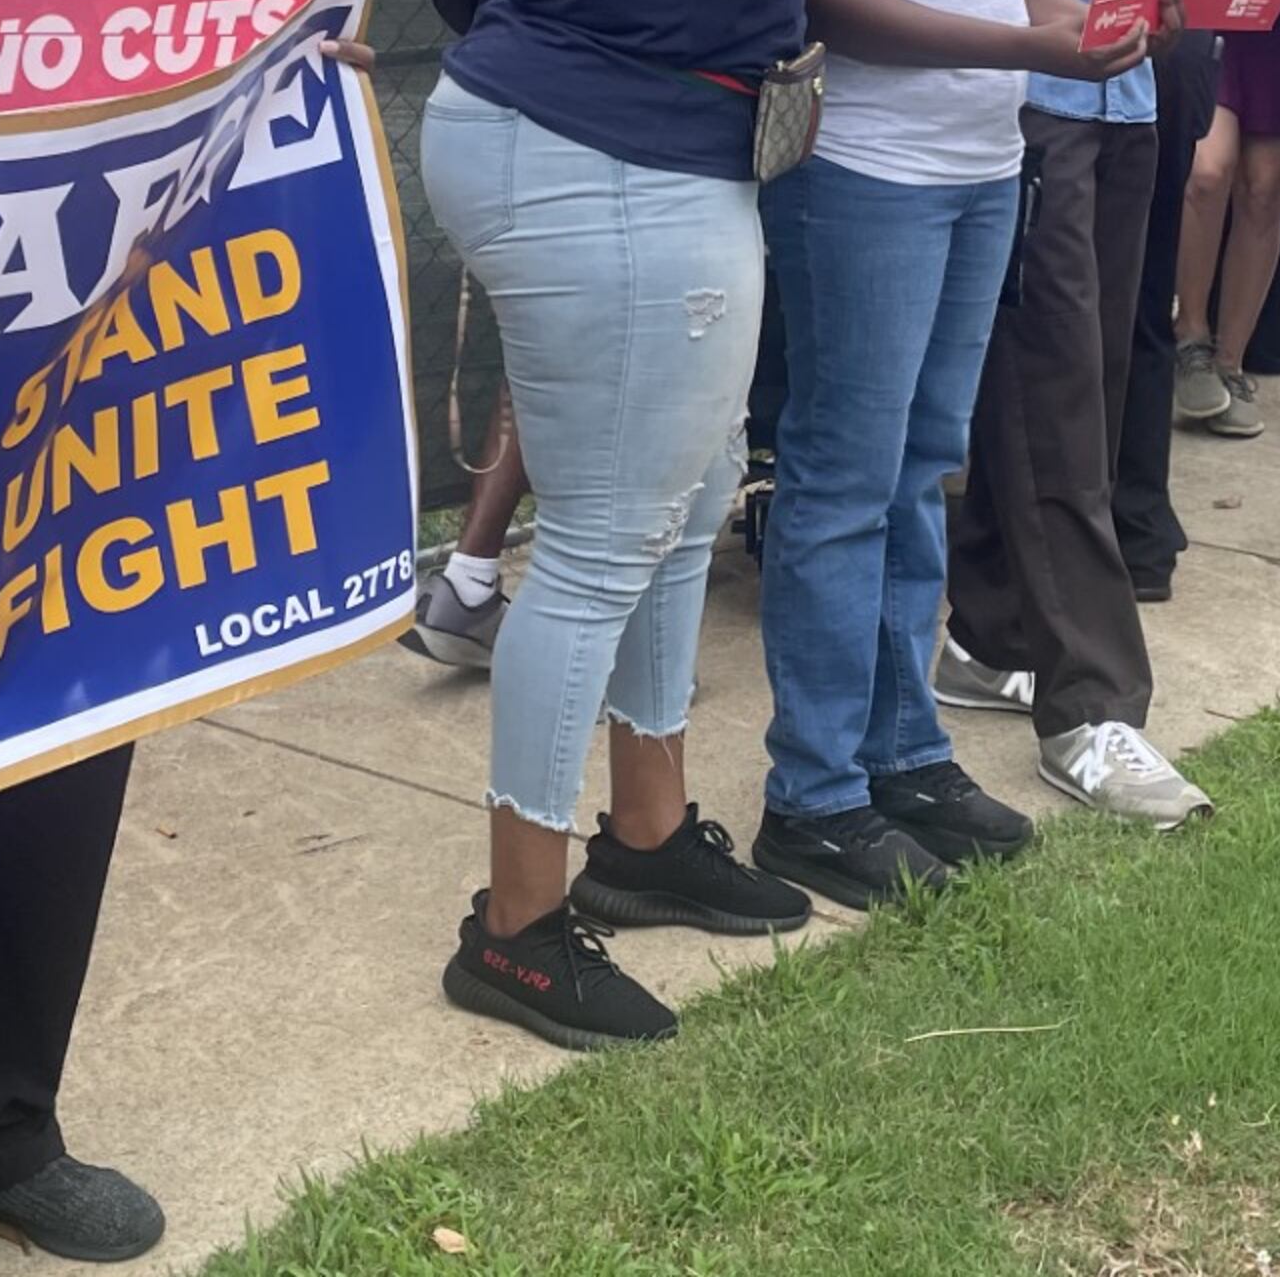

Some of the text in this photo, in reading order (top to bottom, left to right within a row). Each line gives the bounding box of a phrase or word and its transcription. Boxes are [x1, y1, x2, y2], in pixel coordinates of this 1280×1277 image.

[1, 228, 302, 449] STAND
[2, 343, 320, 554] UNITE
[195, 549, 412, 658] LOCAL 2778
